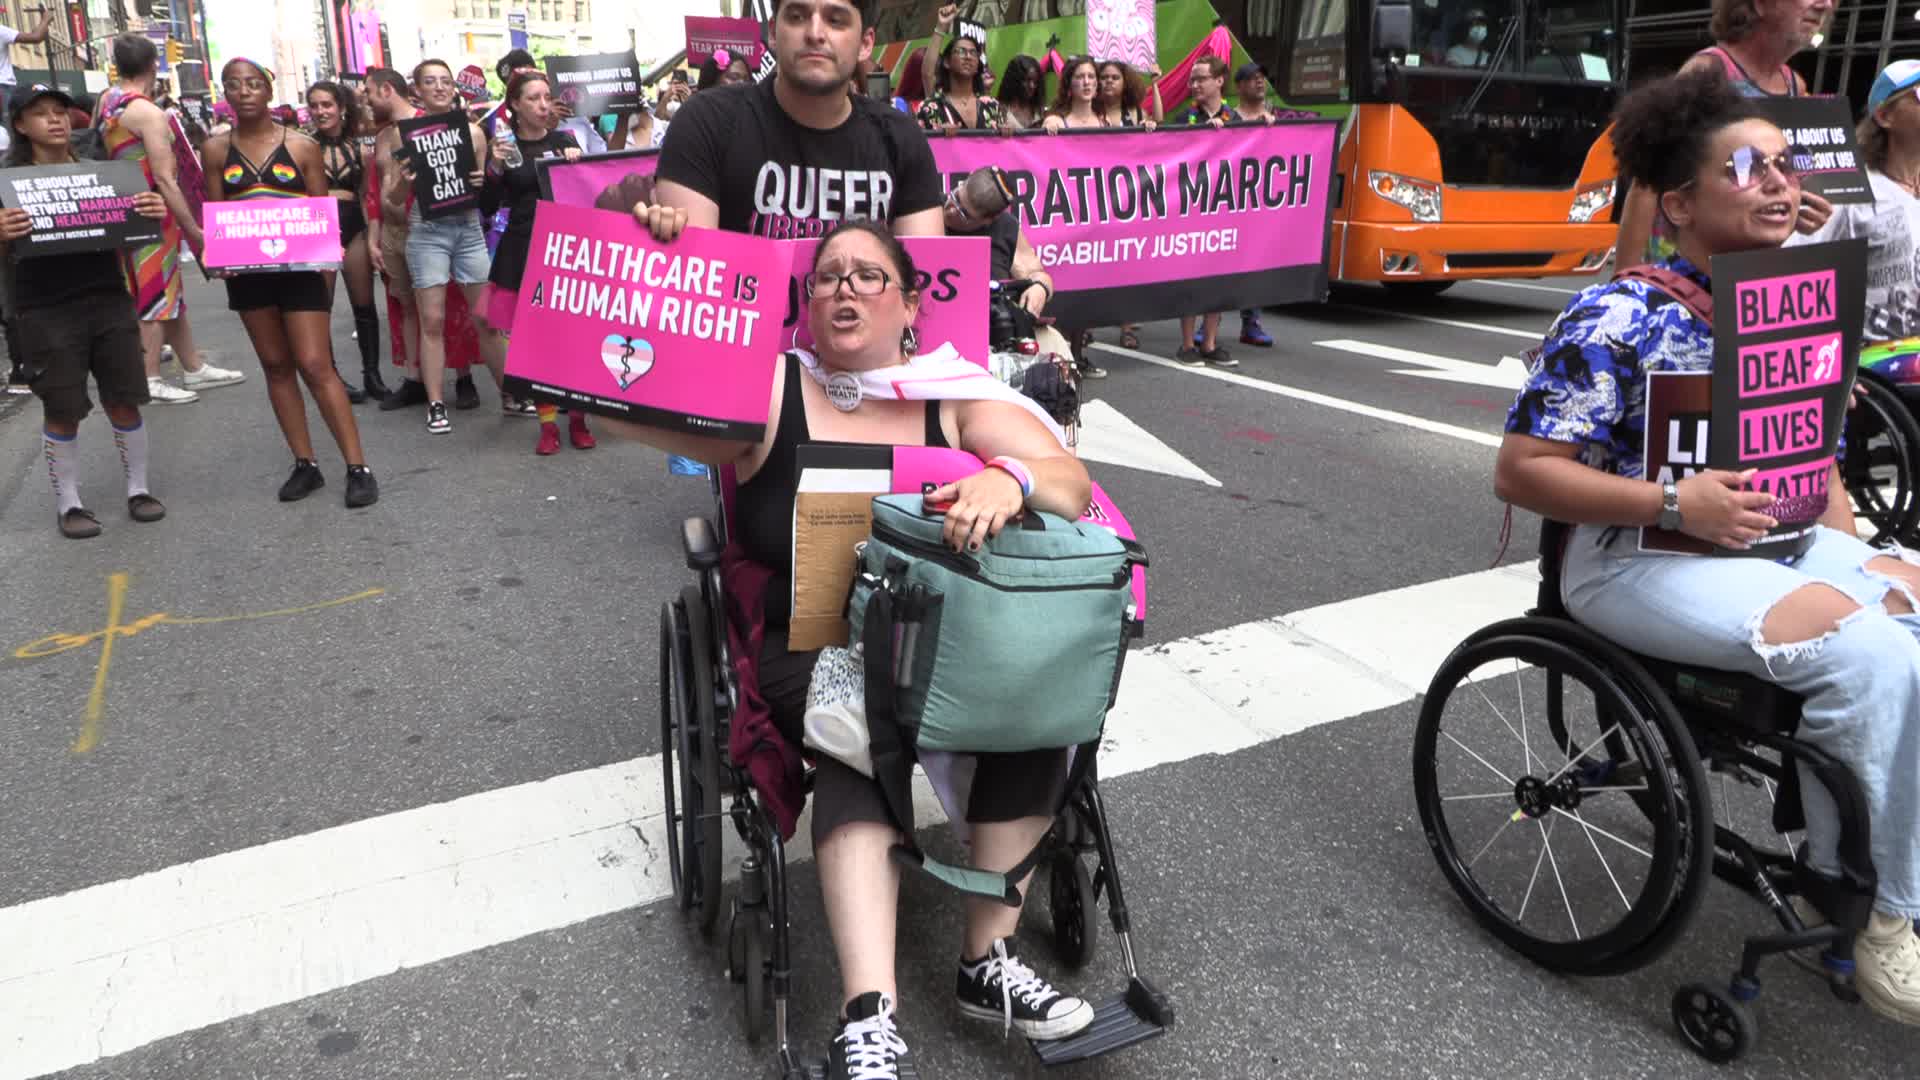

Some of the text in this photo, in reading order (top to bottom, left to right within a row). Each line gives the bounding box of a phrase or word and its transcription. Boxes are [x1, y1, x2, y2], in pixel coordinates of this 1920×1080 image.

[593, 68, 619, 80] ABOUT
[620, 67, 632, 78] US
[624, 81, 637, 92] US!
[411, 128, 463, 153] THANK
[1796, 127, 1829, 145] ABOUT
[1830, 127, 1846, 145] US
[426, 147, 457, 167] GOD
[1836, 151, 1856, 168] US!
[11, 174, 99, 192] WE SHOULDN'T
[435, 164, 456, 183] I'M
[17, 185, 117, 204] HAVE TO CHOOSE
[433, 178, 465, 200] GAY!
[754, 160, 893, 222] QUEER
[940, 154, 1313, 229] RATION MARCH
[22, 197, 137, 217] BETWEEN MARRIAG
[216, 207, 327, 225] HEALTHCARE IS
[55, 210, 127, 228] HEALTHCARE
[214, 220, 329, 240] A HUMAN RIGHT
[1036, 228, 1238, 267] ISABILITY JUSTICE!
[543, 231, 727, 298] HEALTHCARE
[733, 272, 760, 304] IS
[531, 281, 545, 308] A
[550, 275, 654, 328] HUMAN
[658, 296, 761, 347] RIGHT
[1741, 278, 1834, 329] BLACK
[1742, 344, 1814, 393] DEAF
[829, 390, 858, 399] HEALTH
[1743, 410, 1820, 457] LIVES
[1741, 466, 1832, 504] MATTE
